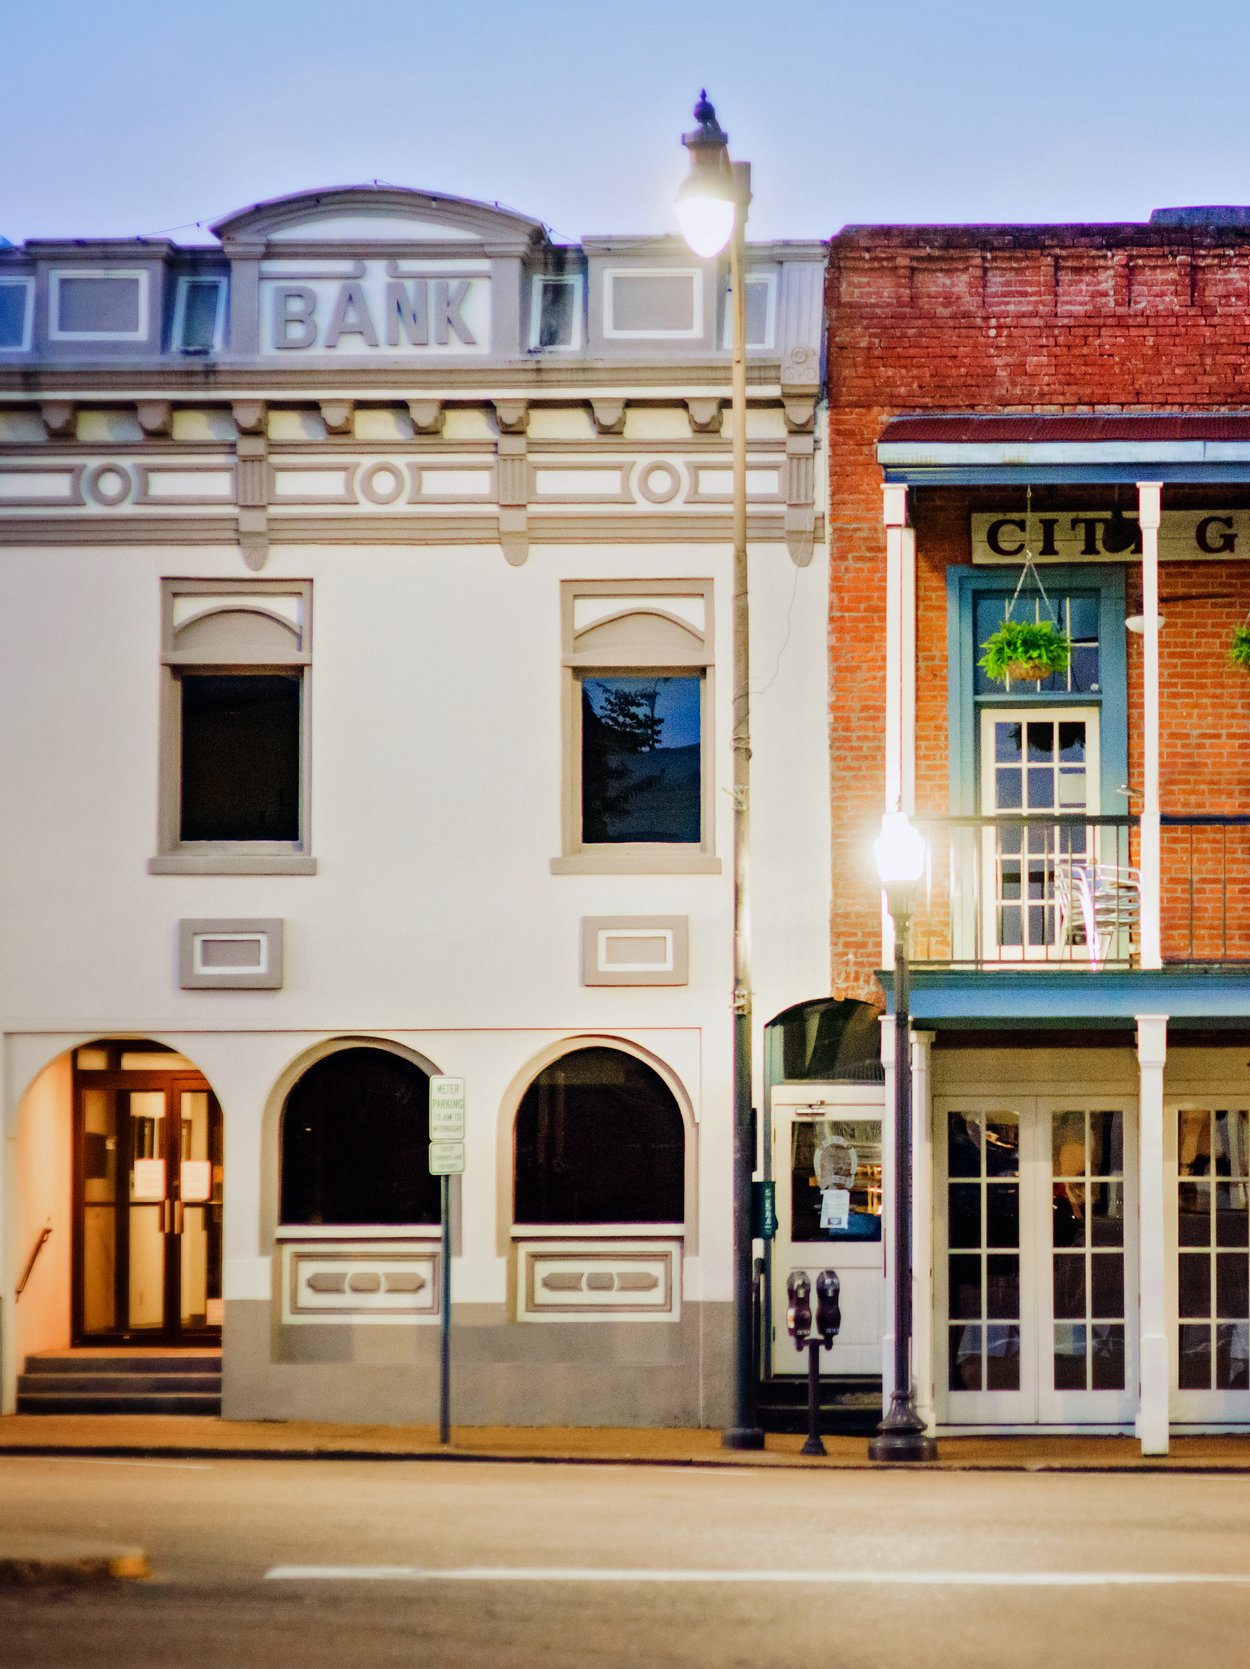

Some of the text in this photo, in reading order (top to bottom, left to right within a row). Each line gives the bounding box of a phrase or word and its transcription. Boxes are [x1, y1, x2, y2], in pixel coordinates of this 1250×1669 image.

[272, 280, 477, 350] BANK
[987, 518, 1144, 556] CIT
[437, 1084, 459, 1095] METER
[432, 1099, 463, 1109] PARKING
